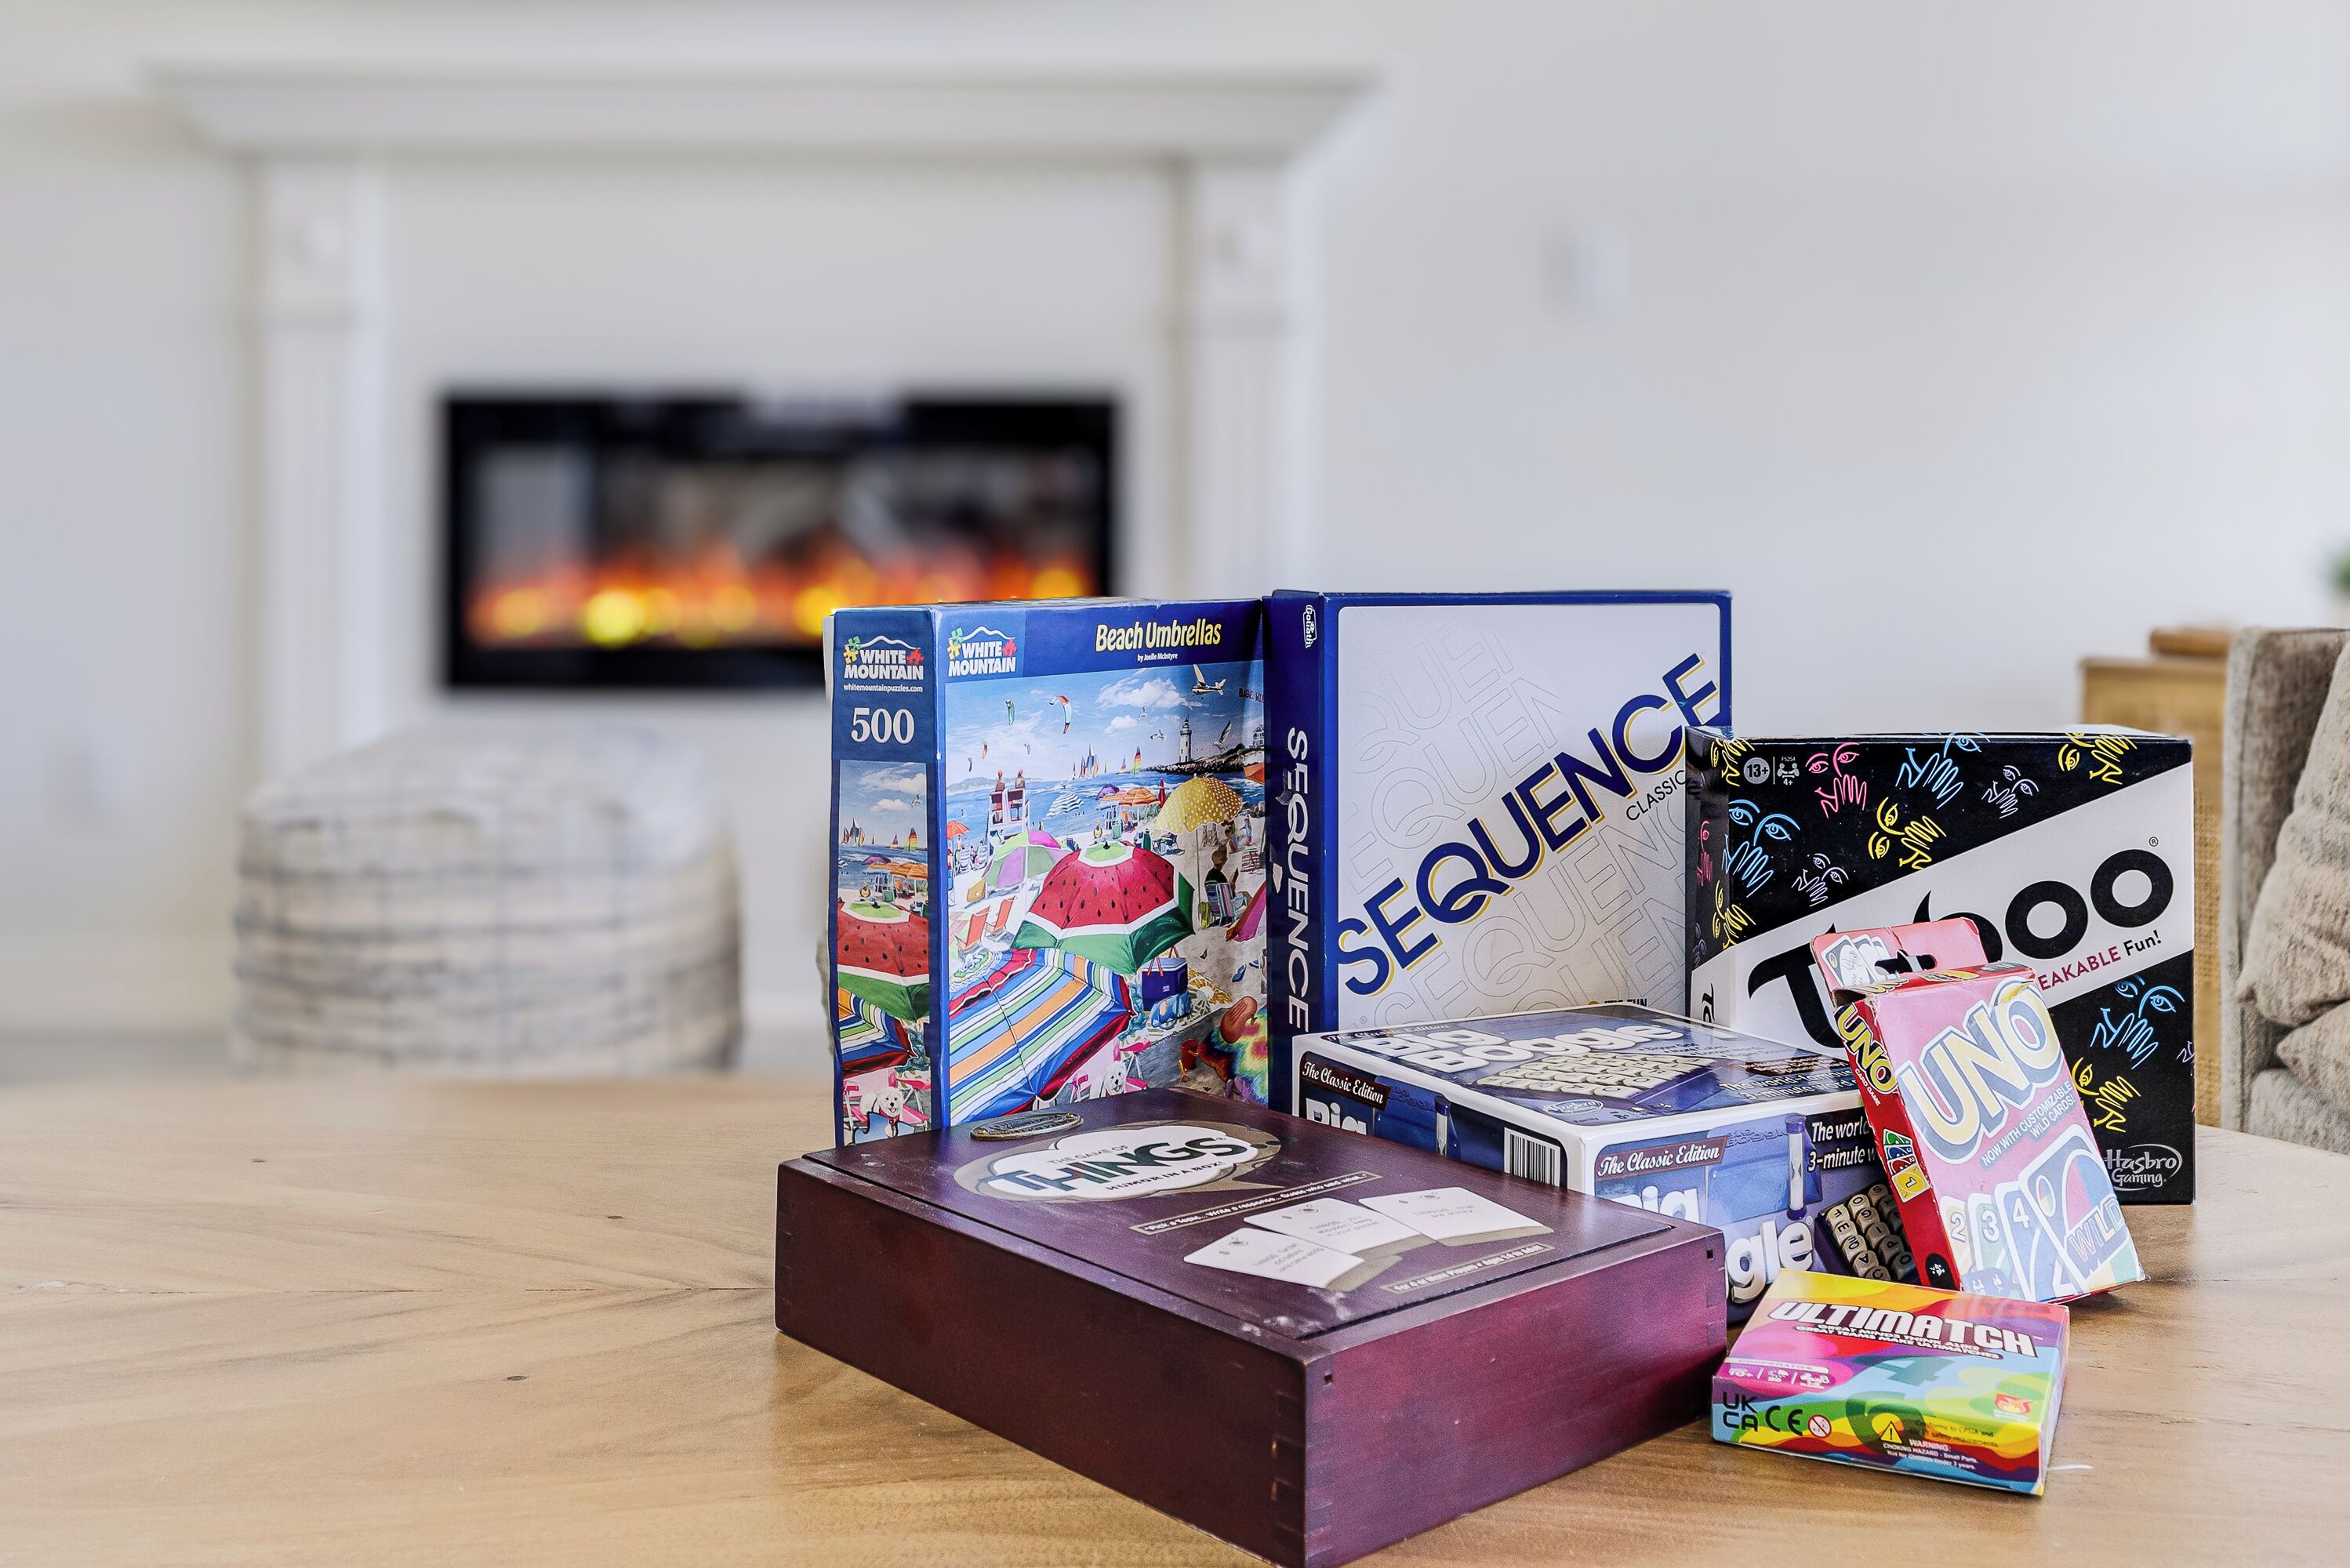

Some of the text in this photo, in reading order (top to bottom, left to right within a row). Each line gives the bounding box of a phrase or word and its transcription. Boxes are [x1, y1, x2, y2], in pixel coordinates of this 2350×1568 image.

[962, 641, 1002, 659] WHITE
[1095, 618, 1222, 652] Beach Umbrellas
[859, 649, 906, 664] WHITE
[948, 657, 1016, 677] MOUNTAIN
[1137, 654, 1144, 662] by
[844, 665, 924, 680] MOUNTAIN
[843, 684, 924, 693] whitemountainpuzzles.com
[851, 707, 915, 744] 500
[1747, 764, 1769, 778] 13+
[1626, 770, 1685, 820] CLASSIC
[1335, 653, 1720, 996] SEQUENCE
[1288, 727, 1309, 1033] SEQUENCE
[2037, 929, 2162, 991] EAKABLE Fun!
[1347, 1029, 1506, 1058] Big
[1398, 1025, 1684, 1073] Boggle
[1835, 1002, 1898, 1094] UNO
[1302, 1062, 1320, 1080] The
[1320, 1067, 1352, 1092] Classic
[1352, 1079, 1384, 1104] Edition
[1899, 982, 2064, 1160] UNO
[1855, 1069, 1881, 1106] CARD GAME
[1981, 1080, 2072, 1167] NOW WITH CUSTOMIZABLE
[2030, 1094, 2076, 1138] WILD CARDS!
[1811, 1122, 1833, 1143] The
[977, 1138, 1248, 1192] THINGS
[1598, 1144, 1720, 1177] The Classic Edition
[1808, 1147, 1864, 1172] 3-minute
[2105, 1149, 2177, 1174] Hasbro
[1106, 1176, 1164, 1191] HUMOR
[2112, 1168, 2163, 1187] Gaming
[1951, 1212, 1966, 1242] 2
[1982, 1210, 1999, 1242] 3
[2013, 1198, 2029, 1229] 4
[2069, 1198, 2126, 1261] WILD
[1769, 1301, 2038, 1358] ULTIMATCH
[1723, 1392, 1758, 1414] UK
[1723, 1405, 1803, 1436] CA CE
[1883, 1443, 1912, 1452] CHOKING
[1913, 1447, 1939, 1457] HAZARD
[1909, 1439, 1952, 1452] WARNING:
